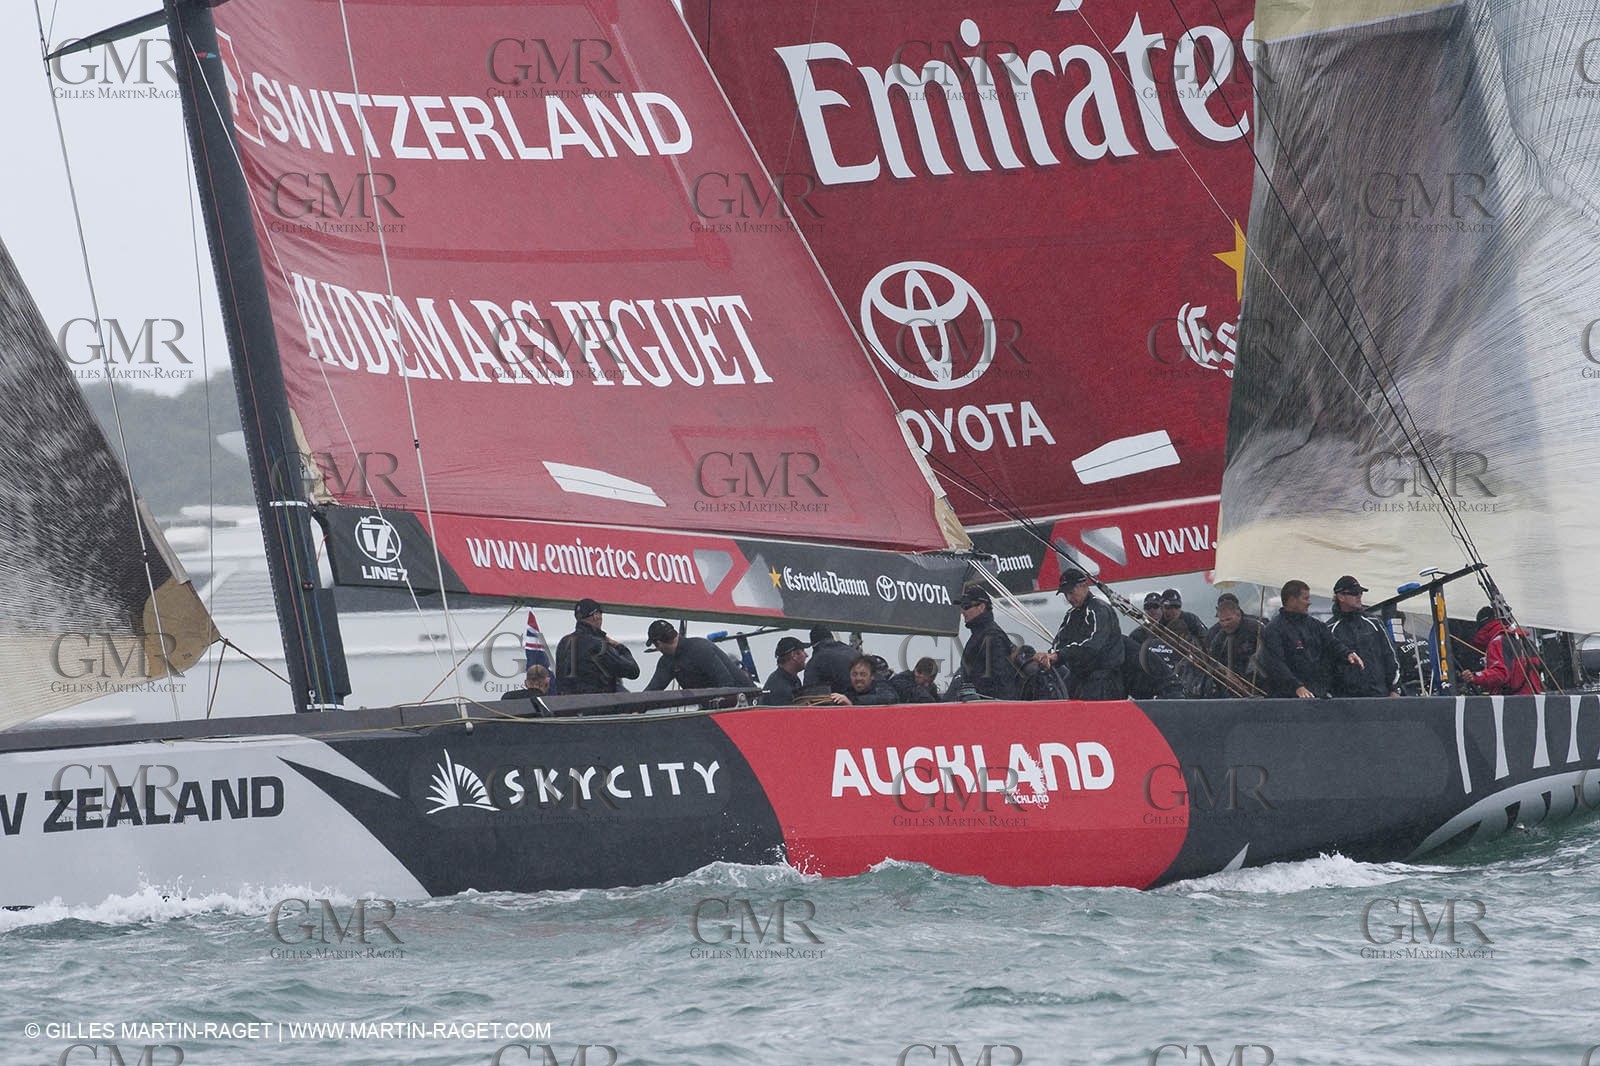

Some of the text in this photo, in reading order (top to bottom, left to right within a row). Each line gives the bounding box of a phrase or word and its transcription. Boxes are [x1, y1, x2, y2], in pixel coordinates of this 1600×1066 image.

[252, 71, 693, 160] SWITZERLAND
[290, 271, 774, 388] AUDEMARS PIGUET
[466, 537, 697, 585] www.emirates.com
[897, 581, 952, 605] TOYOTA
[504, 761, 719, 804] SKYCITY
[832, 742, 1114, 797] AUCKLAND
[43, 776, 285, 833] ZEALAND
